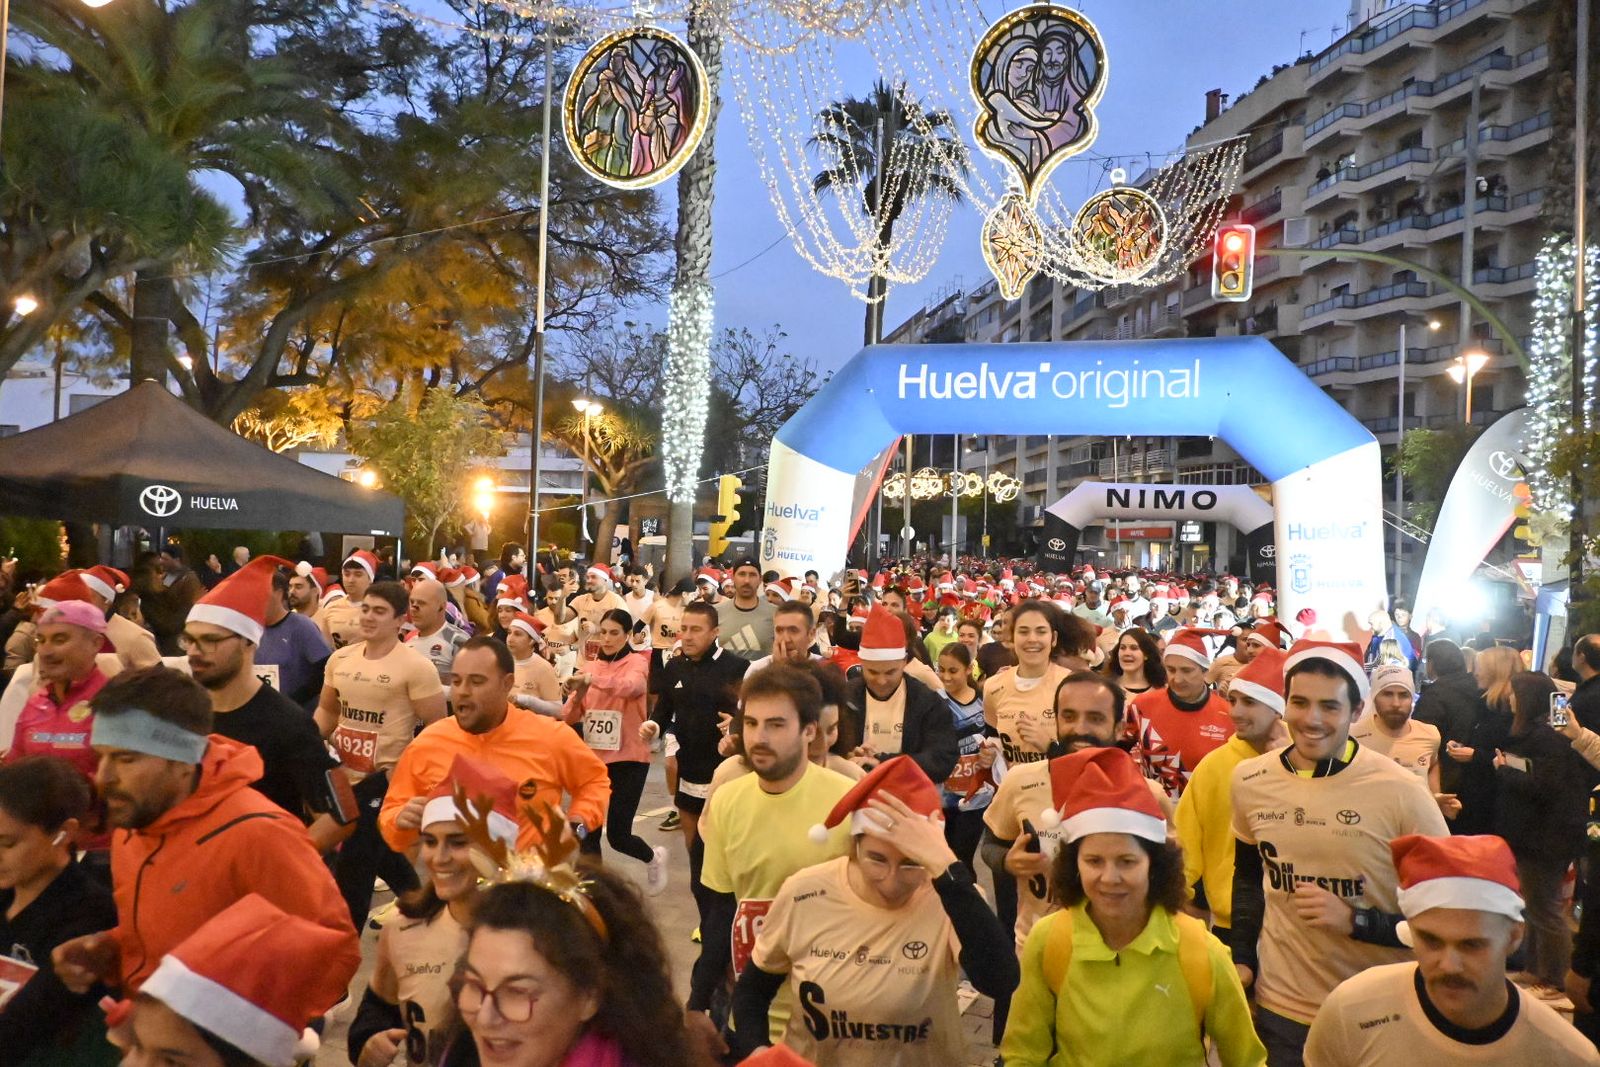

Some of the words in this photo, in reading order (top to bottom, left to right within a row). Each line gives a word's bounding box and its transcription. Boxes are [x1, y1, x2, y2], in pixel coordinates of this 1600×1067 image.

[898, 363, 1036, 399] Huelva
[1051, 359, 1200, 408] original
[1472, 470, 1512, 504] HUELVA
[190, 497, 239, 511] HUELVA
[1106, 489, 1217, 510] NIMO
[767, 502, 819, 520] Huelva
[1288, 522, 1363, 540] Huelva
[777, 552, 814, 561] HUELVA
[341, 707, 385, 724] ILVESTRE
[589, 720, 613, 734] 750
[335, 735, 375, 757] 1928
[1257, 811, 1285, 821] Huelva
[1037, 829, 1058, 839] uelva
[810, 947, 847, 960] Huelva
